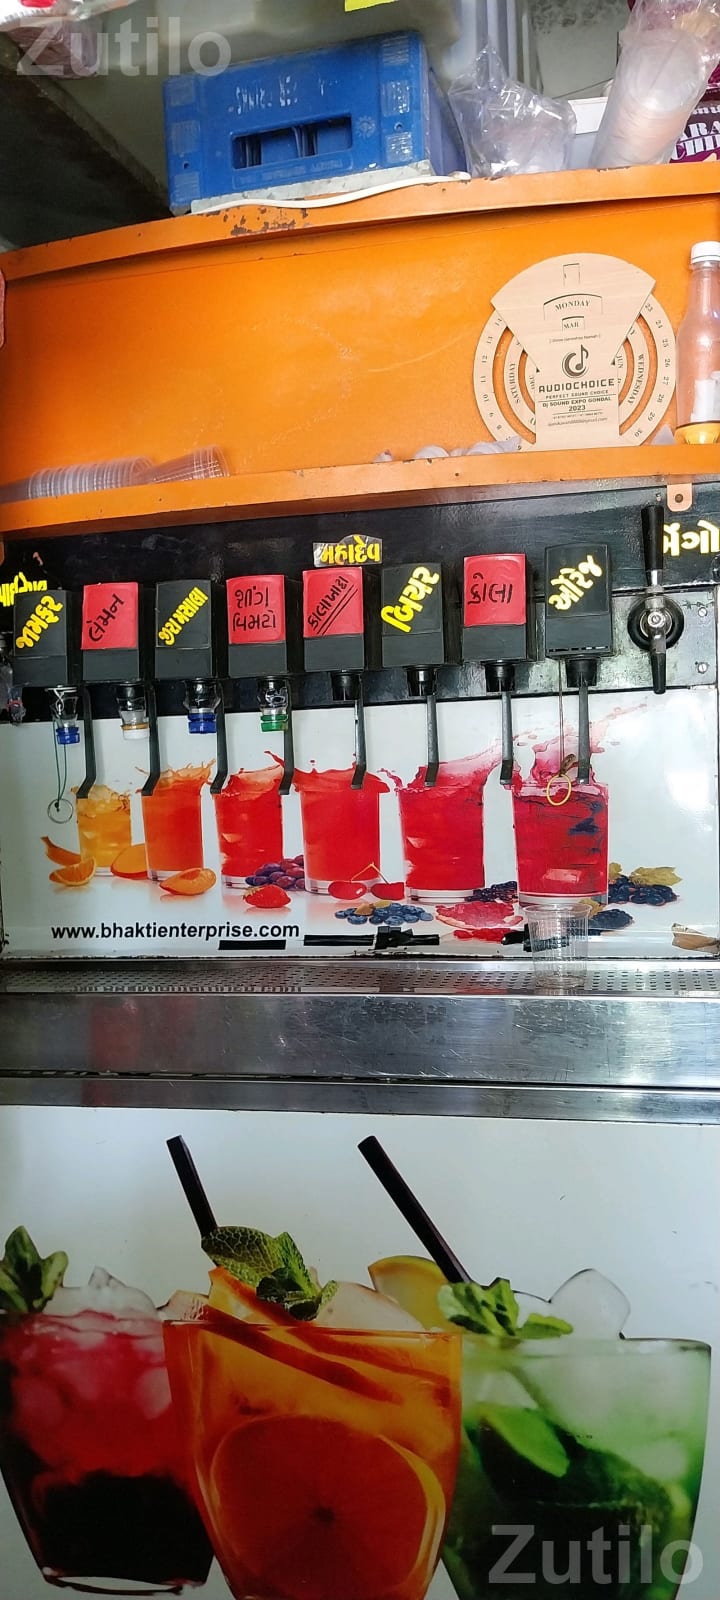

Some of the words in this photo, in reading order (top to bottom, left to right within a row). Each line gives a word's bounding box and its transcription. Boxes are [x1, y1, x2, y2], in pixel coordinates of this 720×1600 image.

[555, 299, 591, 311] MONDAY
[509, 363, 521, 404] SATURDAY
[538, 378, 616, 394] AUDIOCHOICE
[627, 353, 644, 406] WEDNESDAY
[320, 535, 381, 565] મહાદેવ
[86, 593, 125, 642] લેમન
[52, 922, 299, 940] www.bhaktienterprise.com
